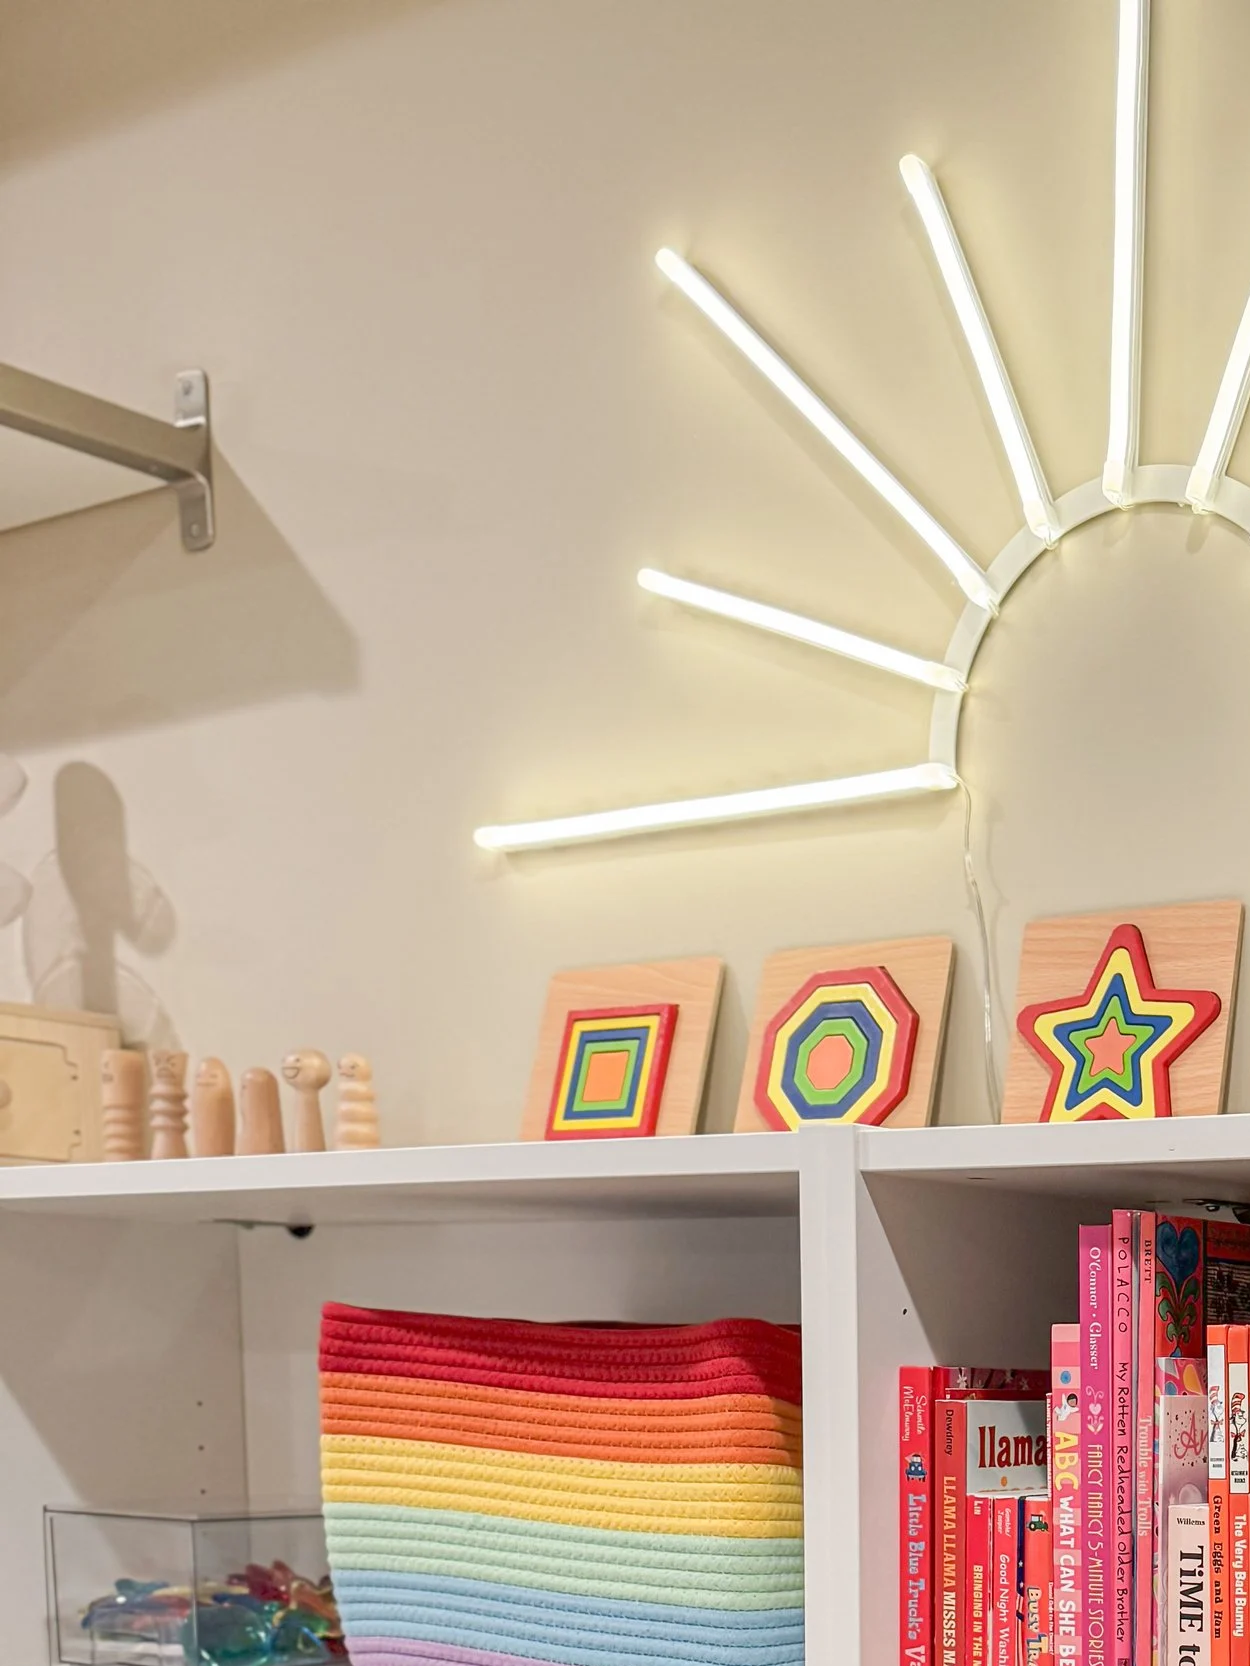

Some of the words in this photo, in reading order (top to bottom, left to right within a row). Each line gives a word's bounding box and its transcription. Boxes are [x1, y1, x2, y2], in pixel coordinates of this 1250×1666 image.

[1144, 1239, 1152, 1283] BRETT
[945, 1409, 954, 1455] Dewdney
[1055, 1431, 1078, 1491] ABC
[1087, 1444, 1103, 1487] FANCY
[943, 1476, 956, 1530] LLAMA
[1060, 1496, 1074, 1547] WHAT
[1087, 1492, 1103, 1535] NANCY
[1234, 1514, 1246, 1530] The
[943, 1534, 956, 1585] LLAMA
[999, 1554, 1009, 1585] Good
[1060, 1554, 1075, 1592] CAN
[1088, 1541, 1104, 1604] 5-MINUTE
[1233, 1539, 1246, 1568] Very
[973, 1565, 983, 1617] BRINGING
[996, 1588, 1009, 1622] Night
[1179, 1545, 1205, 1632] TiME
[1234, 1571, 1246, 1596] Bad
[943, 1591, 955, 1647] MISSES
[973, 1621, 982, 1632] IN
[1058, 1600, 1075, 1636] SHE
[1088, 1609, 1104, 1666] STORIES
[1233, 1599, 1245, 1637] Bunny
[973, 1637, 982, 1656] THE
